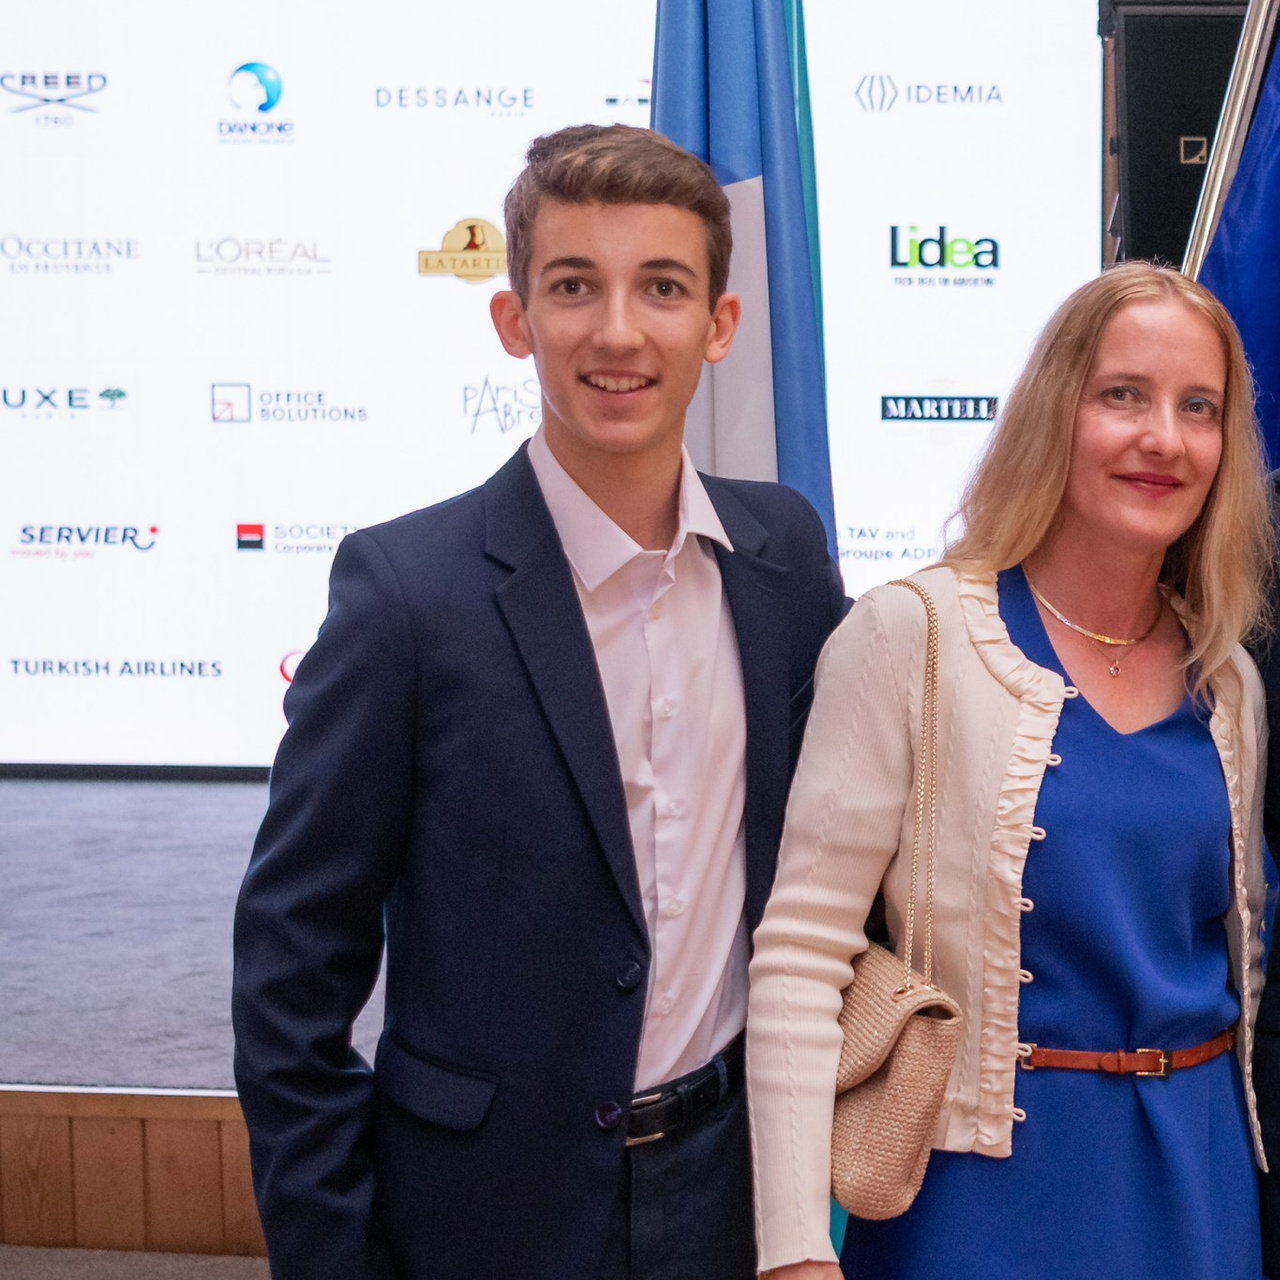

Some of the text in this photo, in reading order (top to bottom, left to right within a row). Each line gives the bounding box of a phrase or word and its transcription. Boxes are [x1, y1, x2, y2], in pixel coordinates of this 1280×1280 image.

[0, 74, 107, 90] CREED
[376, 88, 534, 108] DESSANGE
[906, 85, 1003, 104] IDEMIA
[890, 225, 999, 268] Lidea
[2, 389, 91, 408] UXE
[259, 391, 327, 406] OFFICE
[259, 408, 368, 422] SOLUTIONS
[20, 524, 158, 550] SERVIER
[274, 525, 360, 539] SOCIET
[847, 528, 879, 539] TAV
[10, 659, 223, 678] TURKISH AIRLINES
